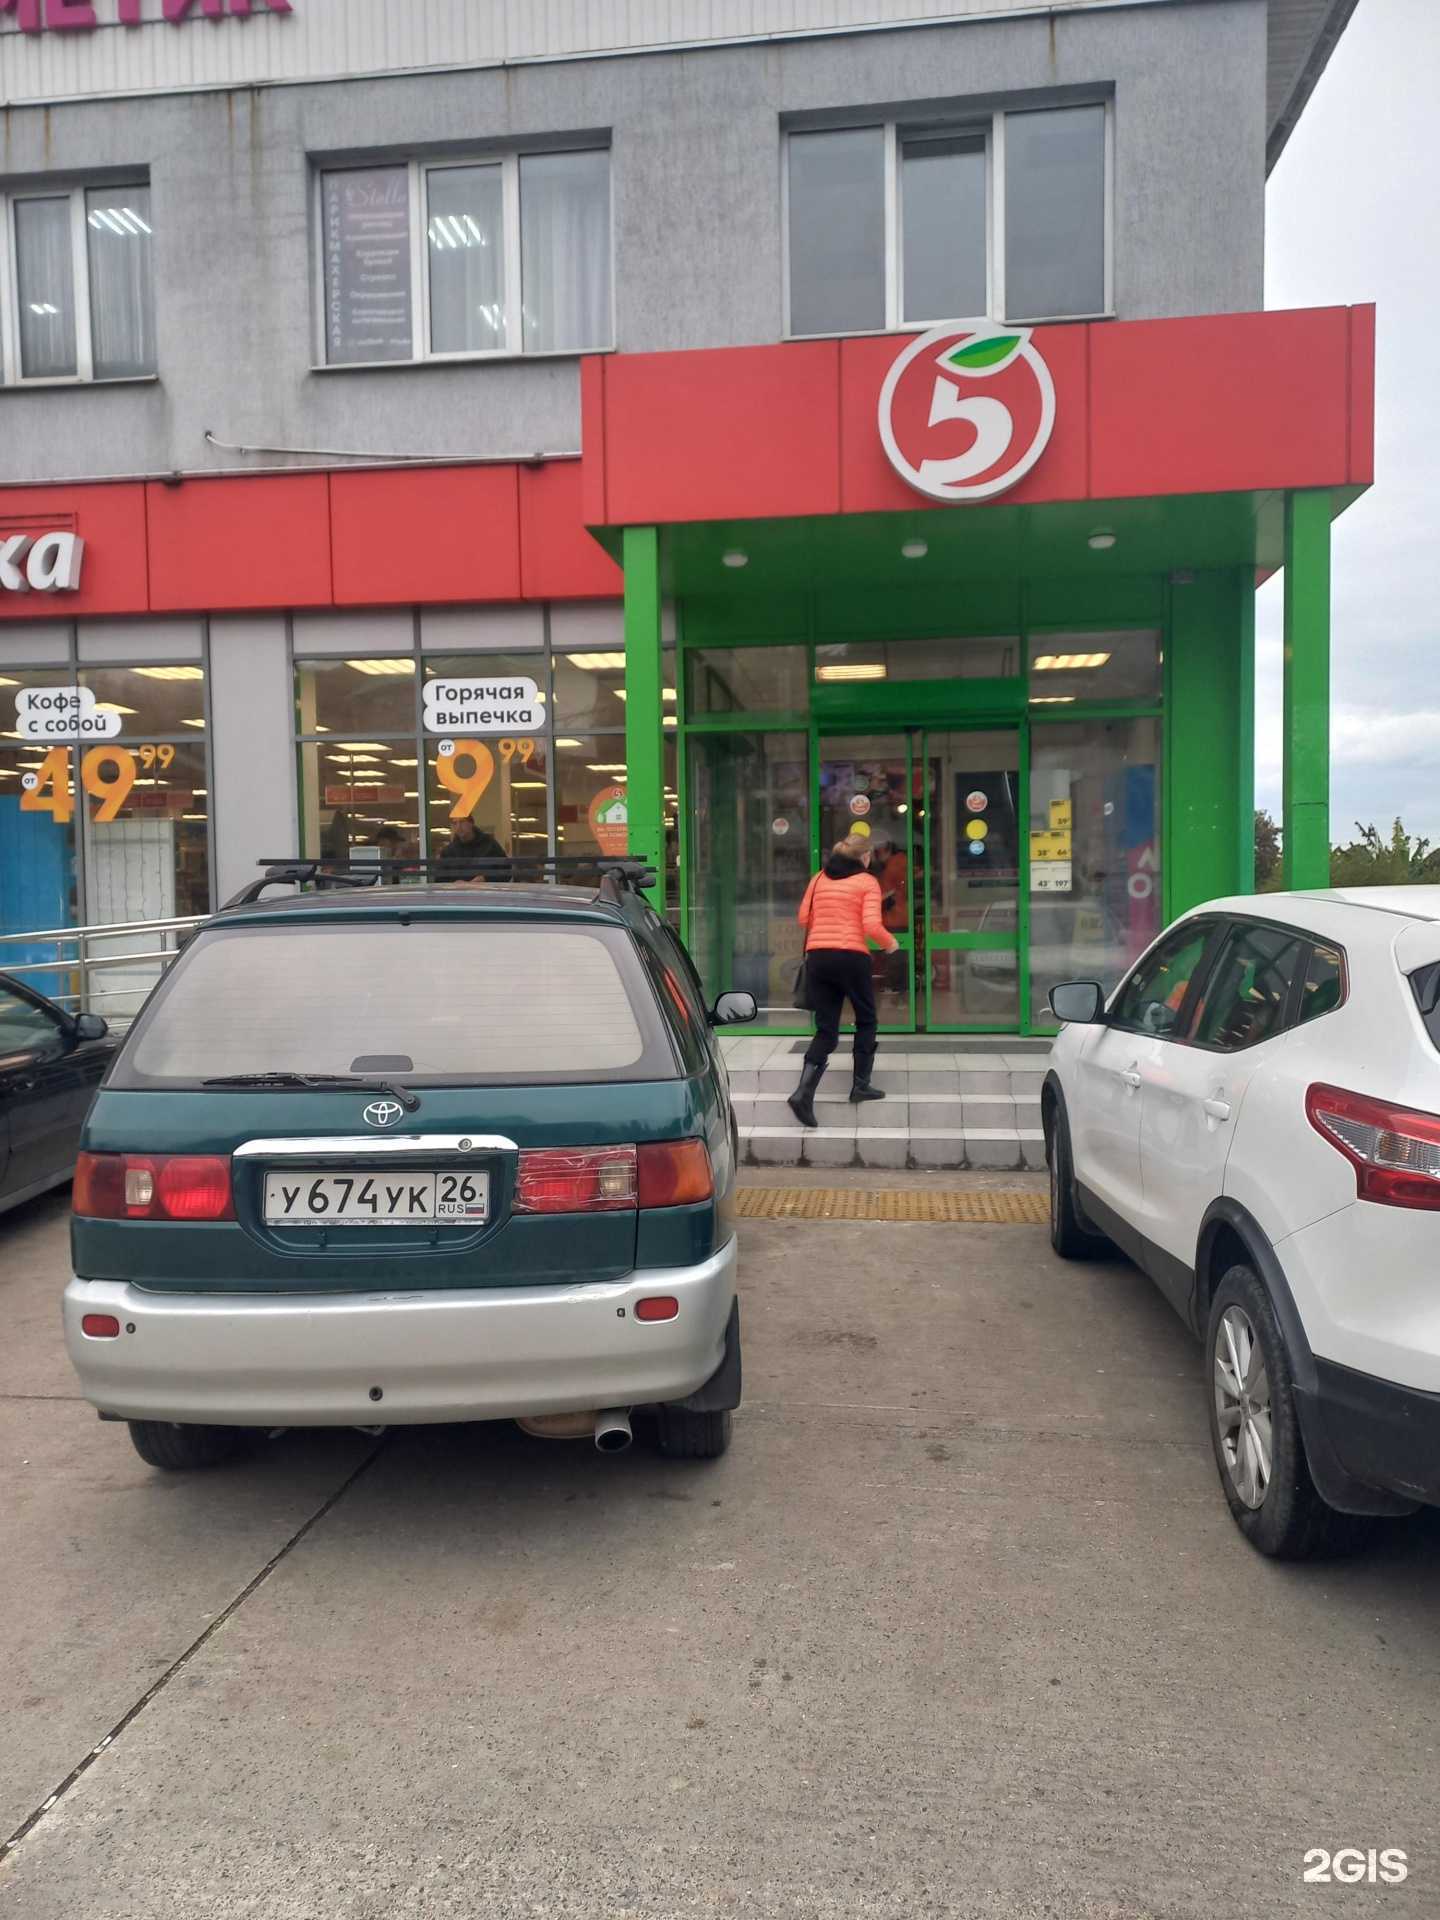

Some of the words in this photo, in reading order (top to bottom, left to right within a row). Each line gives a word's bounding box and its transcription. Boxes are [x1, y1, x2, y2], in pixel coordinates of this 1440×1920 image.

[27, 693, 81, 713] Кофе
[435, 685, 525, 704] Горячая
[45, 714, 107, 732] собой
[436, 708, 533, 725] выпечка
[139, 743, 176, 769] 99
[441, 743, 453, 752] от
[498, 738, 535, 763] 99
[20, 744, 137, 823] 49
[24, 777, 36, 785] от
[437, 739, 495, 818] 9
[281, 1178, 428, 1214] У674УК
[441, 1175, 477, 1203] 26
[438, 1203, 465, 1214] RUS
